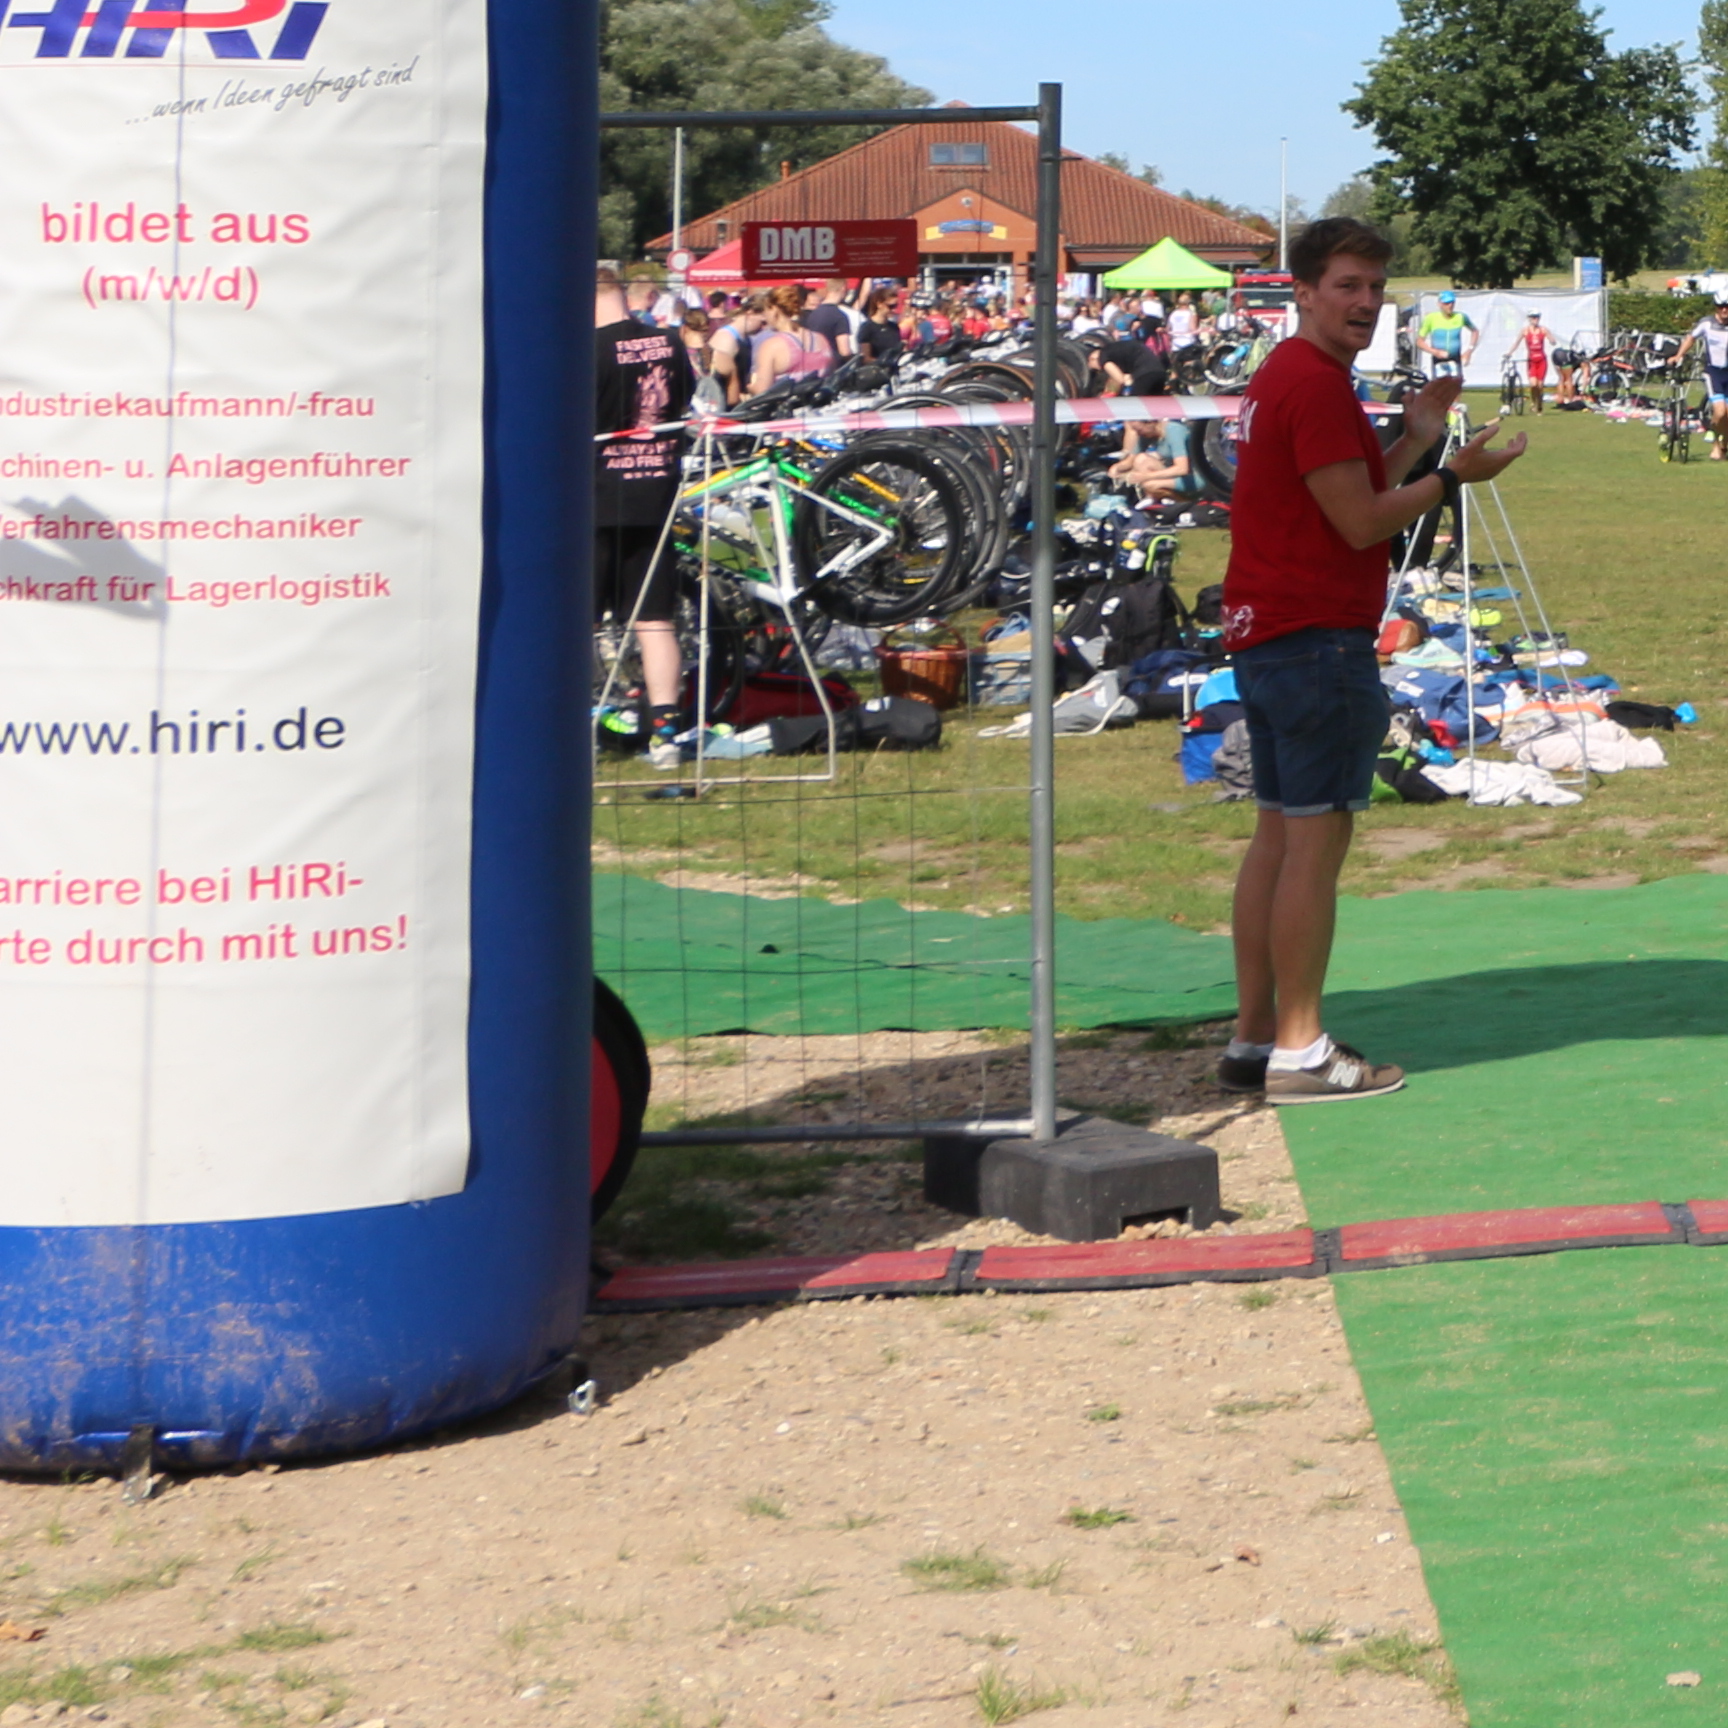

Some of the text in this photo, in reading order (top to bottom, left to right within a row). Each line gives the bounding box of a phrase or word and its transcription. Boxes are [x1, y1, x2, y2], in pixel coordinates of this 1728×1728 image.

[273, 65, 370, 113] gefragt
[373, 55, 421, 87] sind
[40, 202, 311, 246] bildet aus
[759, 226, 836, 261] DMB
[81, 266, 260, 311] (m/w/d)
[0, 390, 375, 419] dustriekaufmann/-frau
[124, 460, 154, 480] u.
[166, 451, 411, 486] Anlagenführer
[0, 512, 363, 542] erfahrensmechaniker
[106, 574, 156, 603] für
[165, 572, 391, 609] Lagerlogistik
[0, 706, 346, 756] www.hiri.de
[156, 867, 231, 906] bei
[247, 860, 364, 903] HiRi-
[65, 927, 205, 967] durch
[220, 922, 300, 963] mit
[311, 913, 409, 958] uns!
